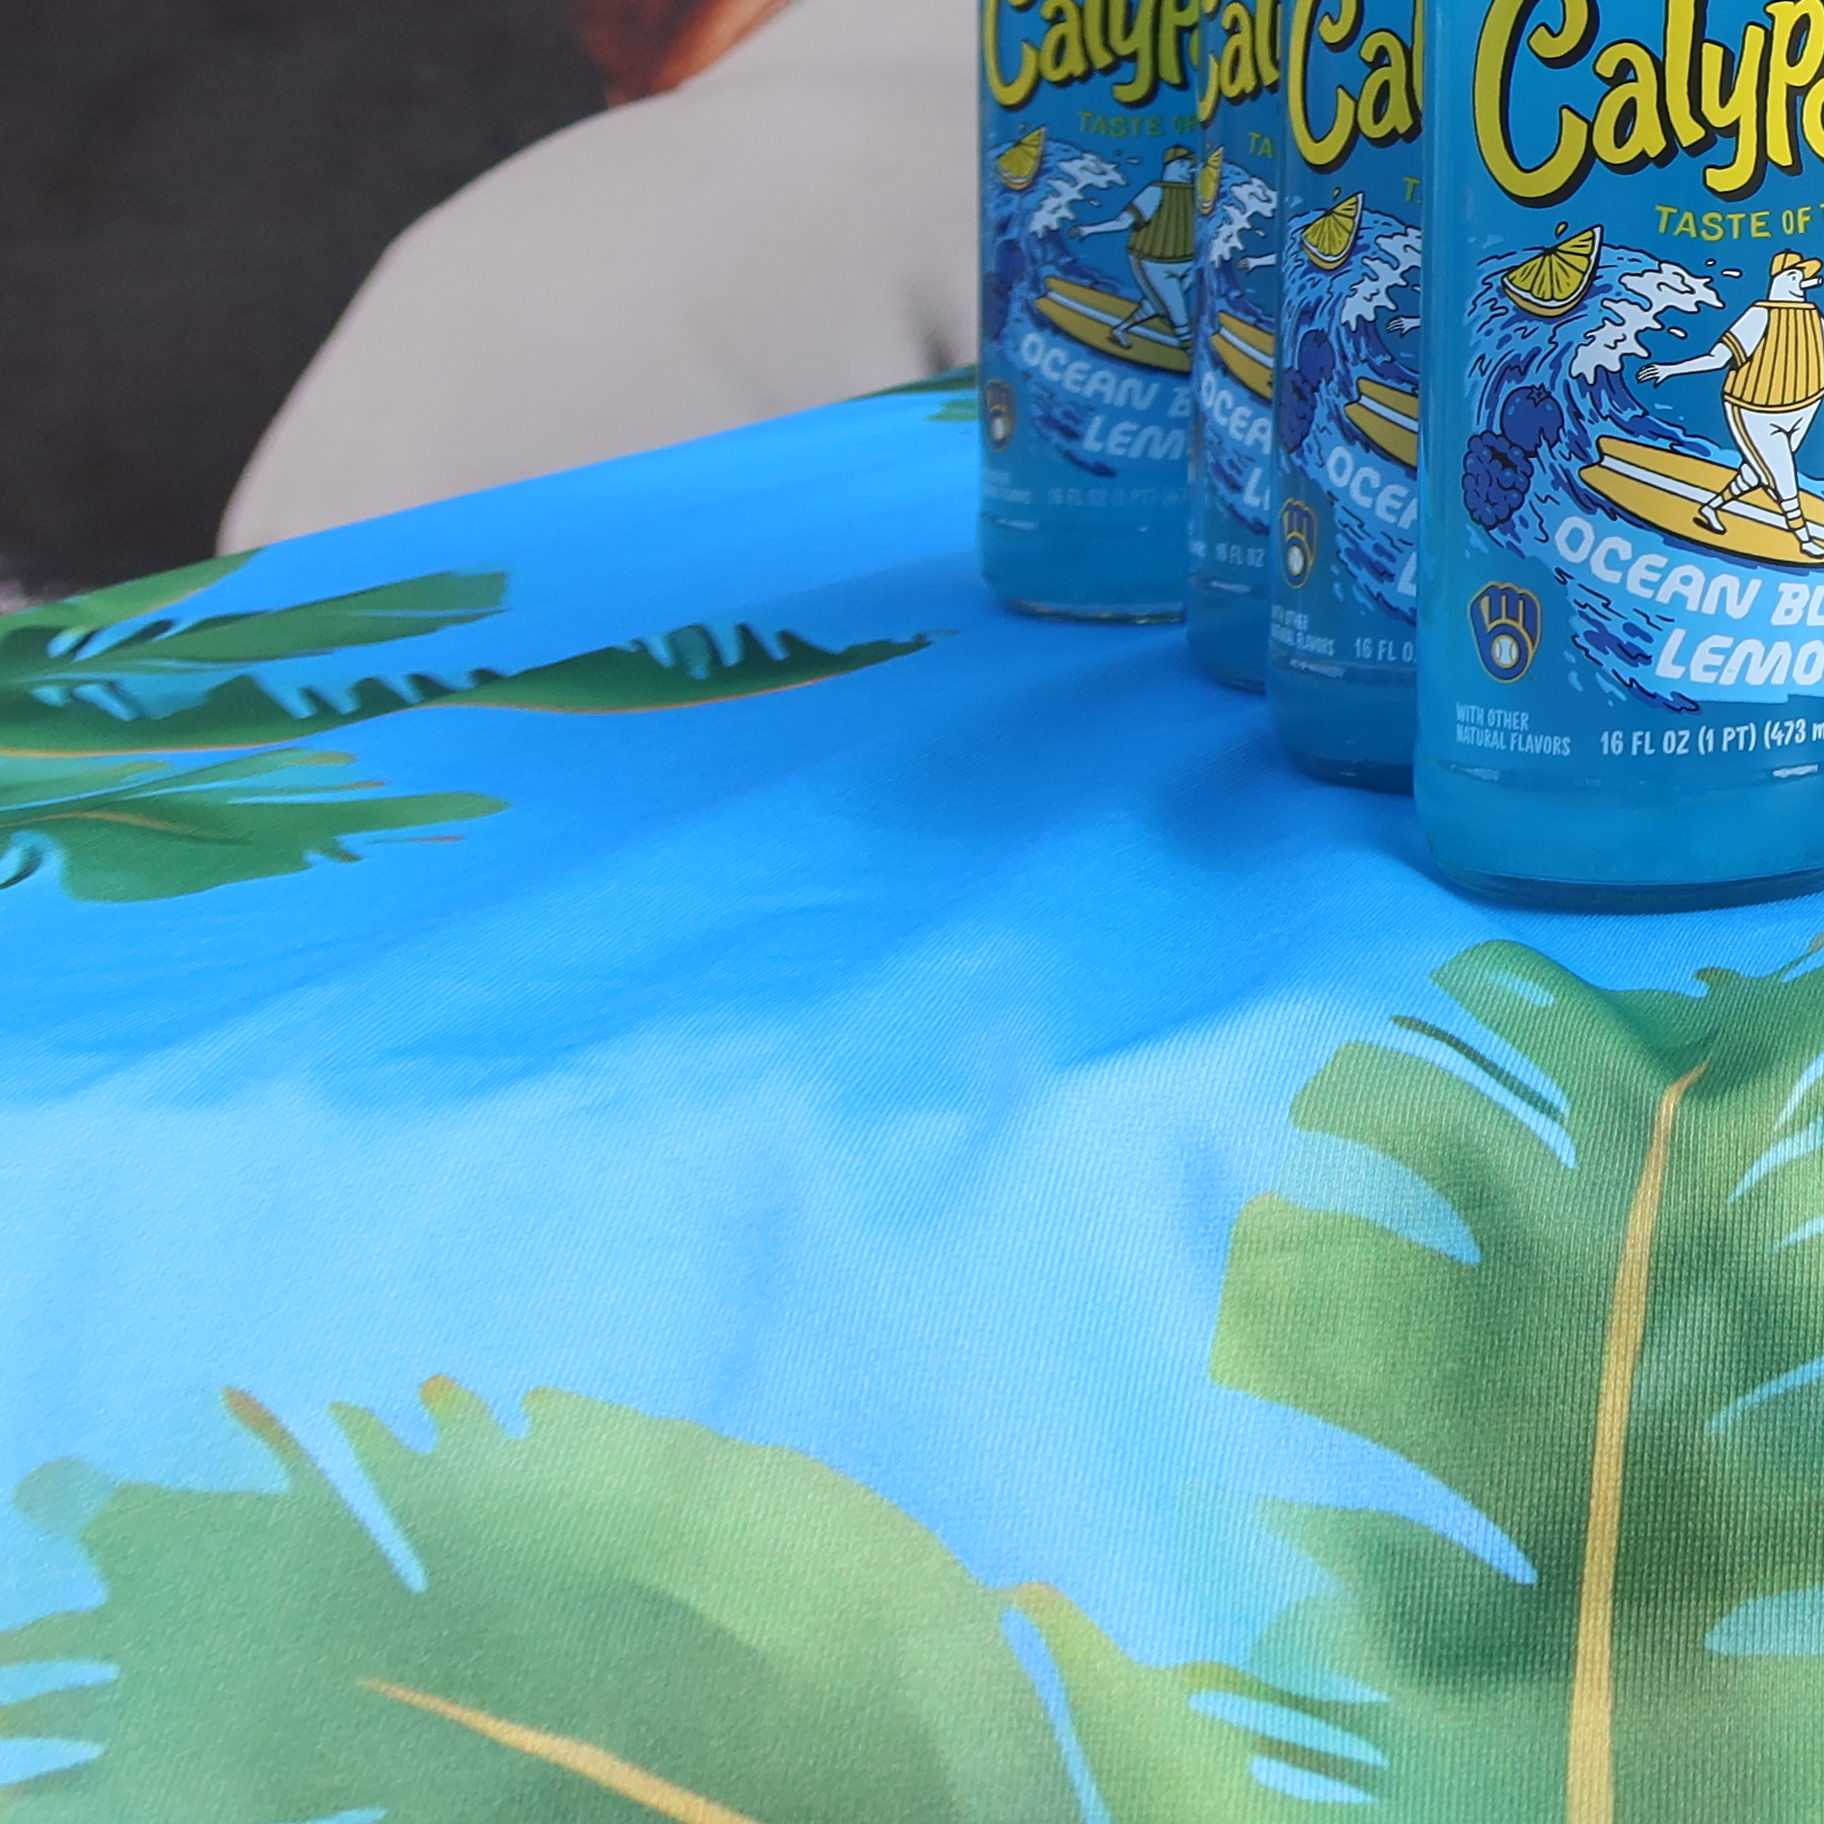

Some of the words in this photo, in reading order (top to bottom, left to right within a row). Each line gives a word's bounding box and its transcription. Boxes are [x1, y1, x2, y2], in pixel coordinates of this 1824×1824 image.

[1079, 110, 1164, 138] TASTE
[1656, 204, 1771, 242] TASTE
[1781, 203, 1811, 235] OF
[1019, 332, 1160, 408] OCEAN
[1200, 372, 1271, 456] OCEA
[1326, 446, 1417, 529] OCE
[1554, 515, 1763, 620] OCEAN
[1354, 636, 1373, 660] 16
[1377, 638, 1398, 662] FL
[1401, 639, 1417, 663] O
[1456, 702, 1484, 724] WITH
[1488, 709, 1529, 731] OTHER
[1456, 723, 1507, 751] NATURAL
[1510, 732, 1571, 757] FLAVORS
[1600, 730, 1623, 756] 16
[1631, 731, 1655, 757] FL
[1663, 729, 1689, 756] OZ
[1696, 726, 1714, 756] (1
[1722, 722, 1756, 753] PT)
[1763, 718, 1806, 750] (473
